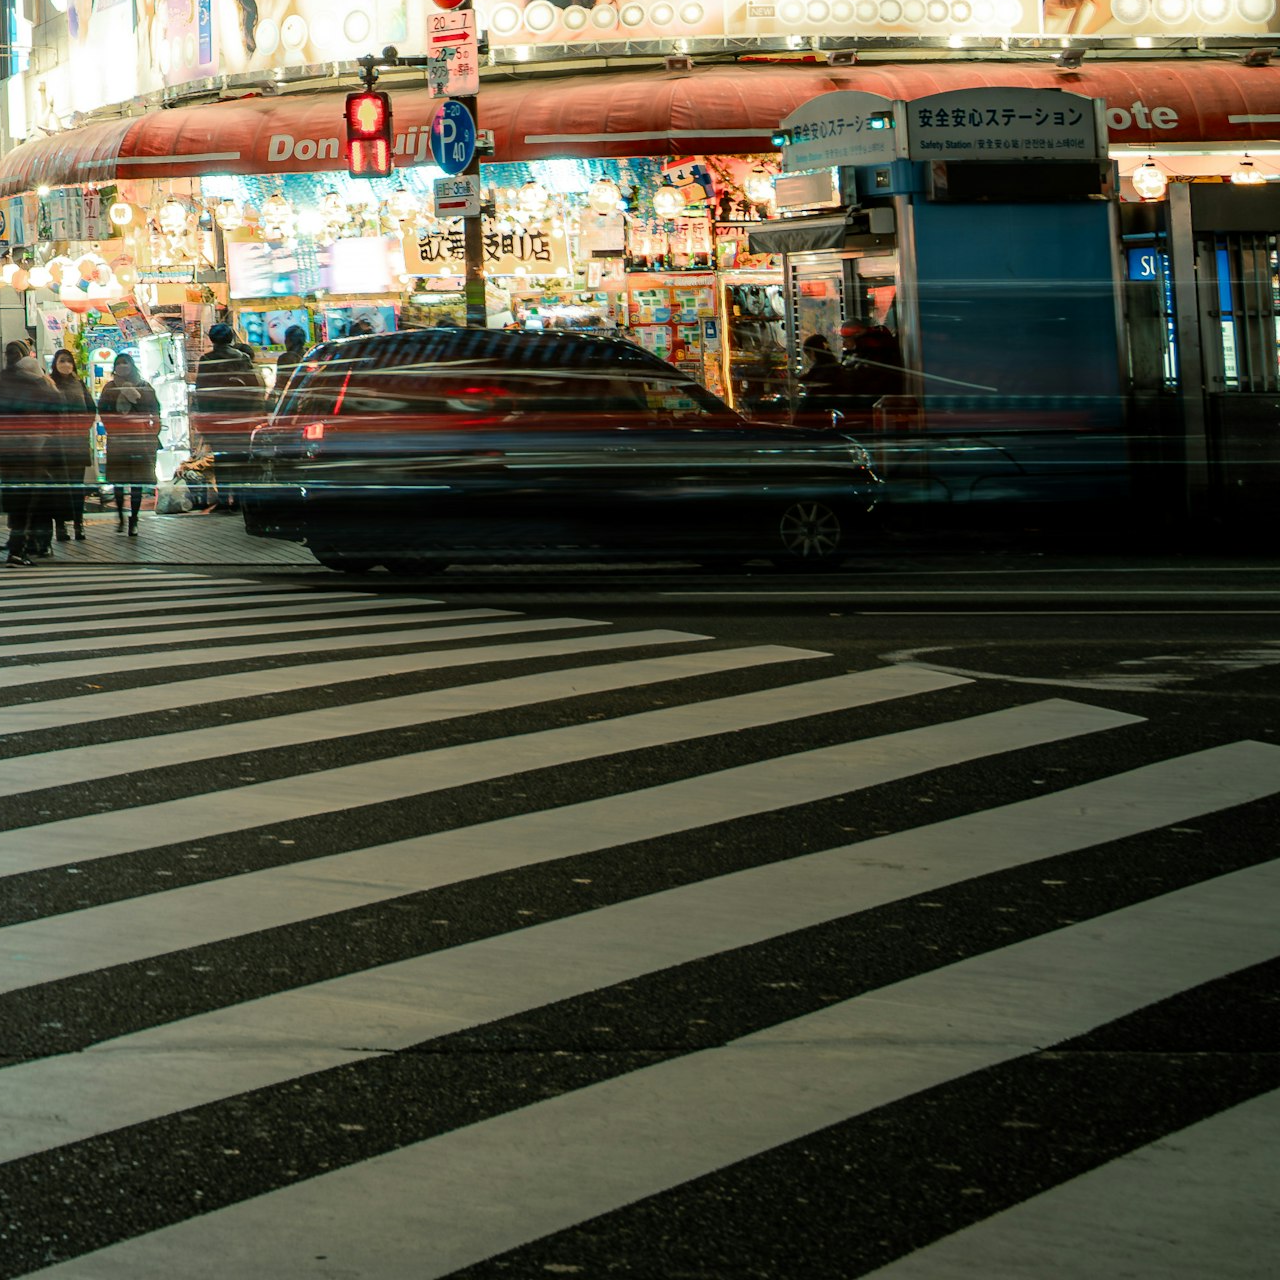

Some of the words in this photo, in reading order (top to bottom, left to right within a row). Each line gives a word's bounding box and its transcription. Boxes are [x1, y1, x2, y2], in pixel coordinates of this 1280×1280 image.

[919, 108, 1083, 129] 安全安心ステーション
[267, 134, 339, 162] Don
[441, 118, 457, 164] P
[453, 141, 466, 163] 40
[919, 140, 944, 152] Safety
[945, 140, 973, 151] Station
